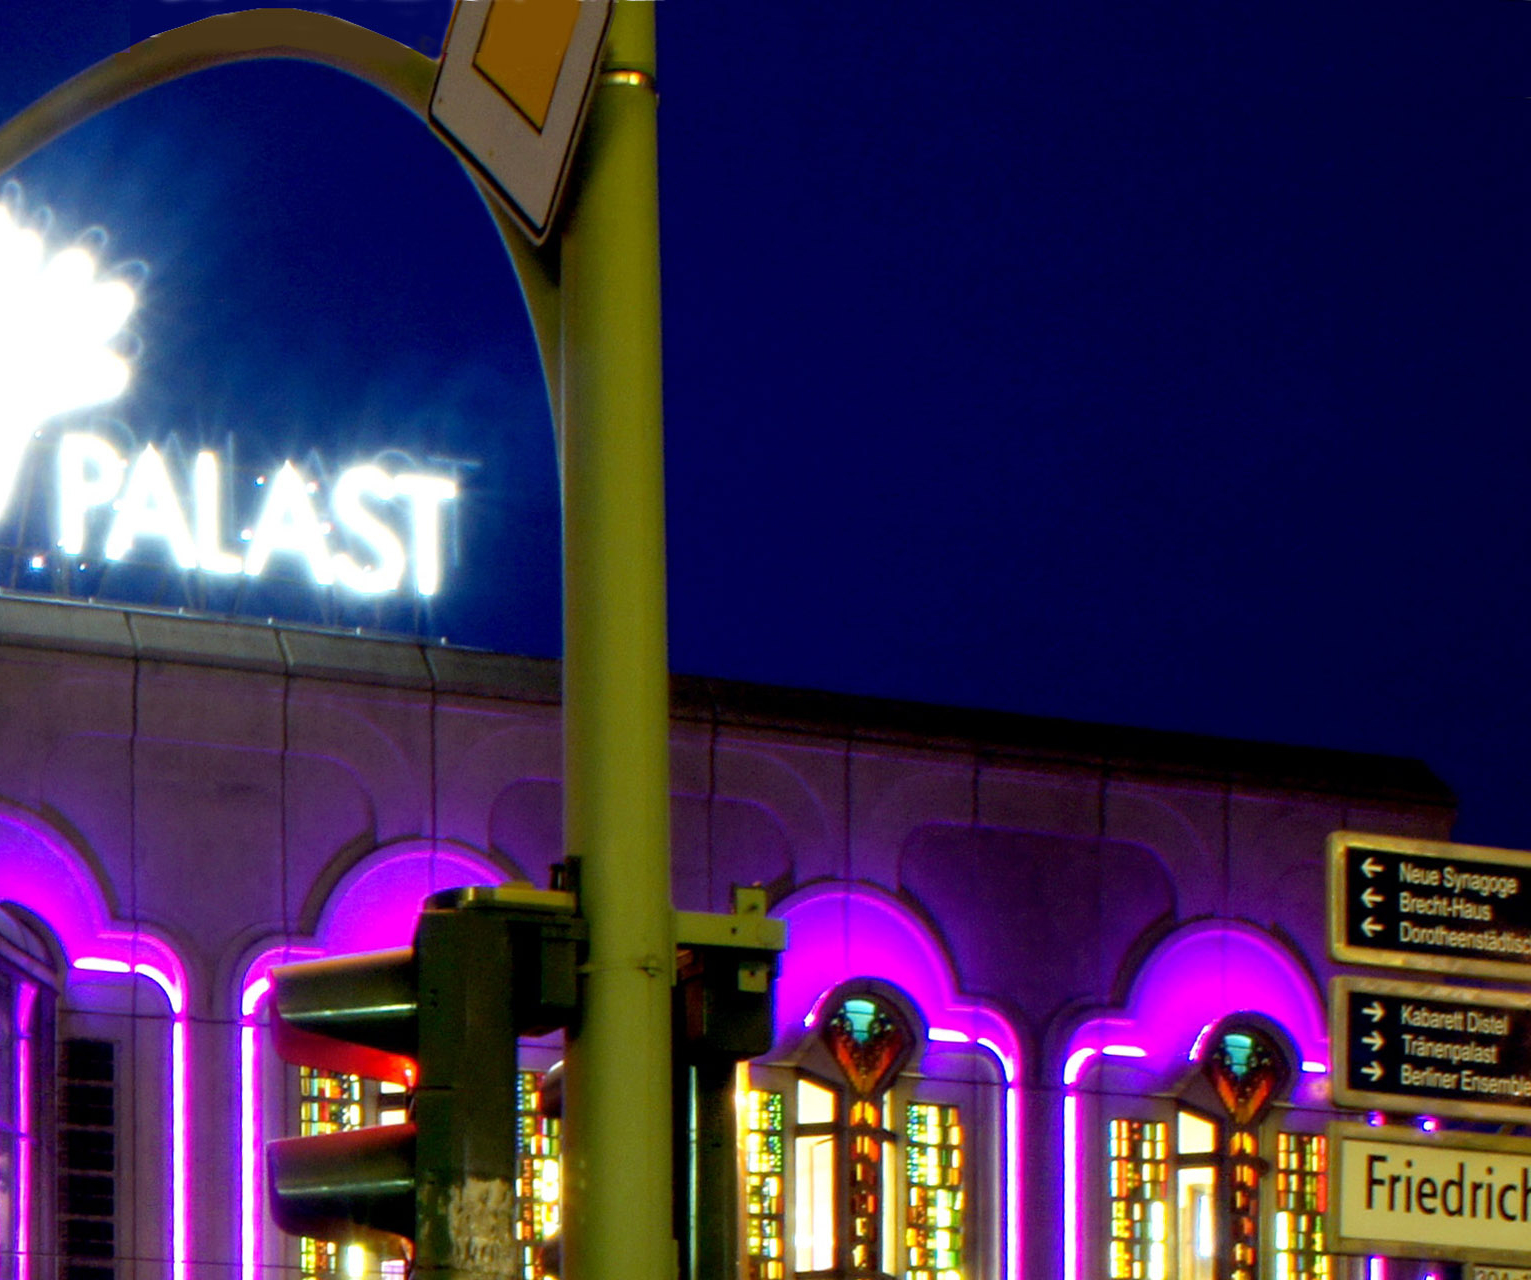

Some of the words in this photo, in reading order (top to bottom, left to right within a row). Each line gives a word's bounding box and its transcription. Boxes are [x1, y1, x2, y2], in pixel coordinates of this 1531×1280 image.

[59, 433, 458, 596] PALAST
[1399, 861, 1441, 886] Neue
[1443, 865, 1518, 898] Synagoge
[1399, 891, 1493, 920] Brecht-Haus
[1401, 1004, 1465, 1031] Kabarett
[1467, 1011, 1509, 1036] Distel
[1401, 1034, 1499, 1064] Tränenpalast
[1401, 1063, 1459, 1089] Berliner
